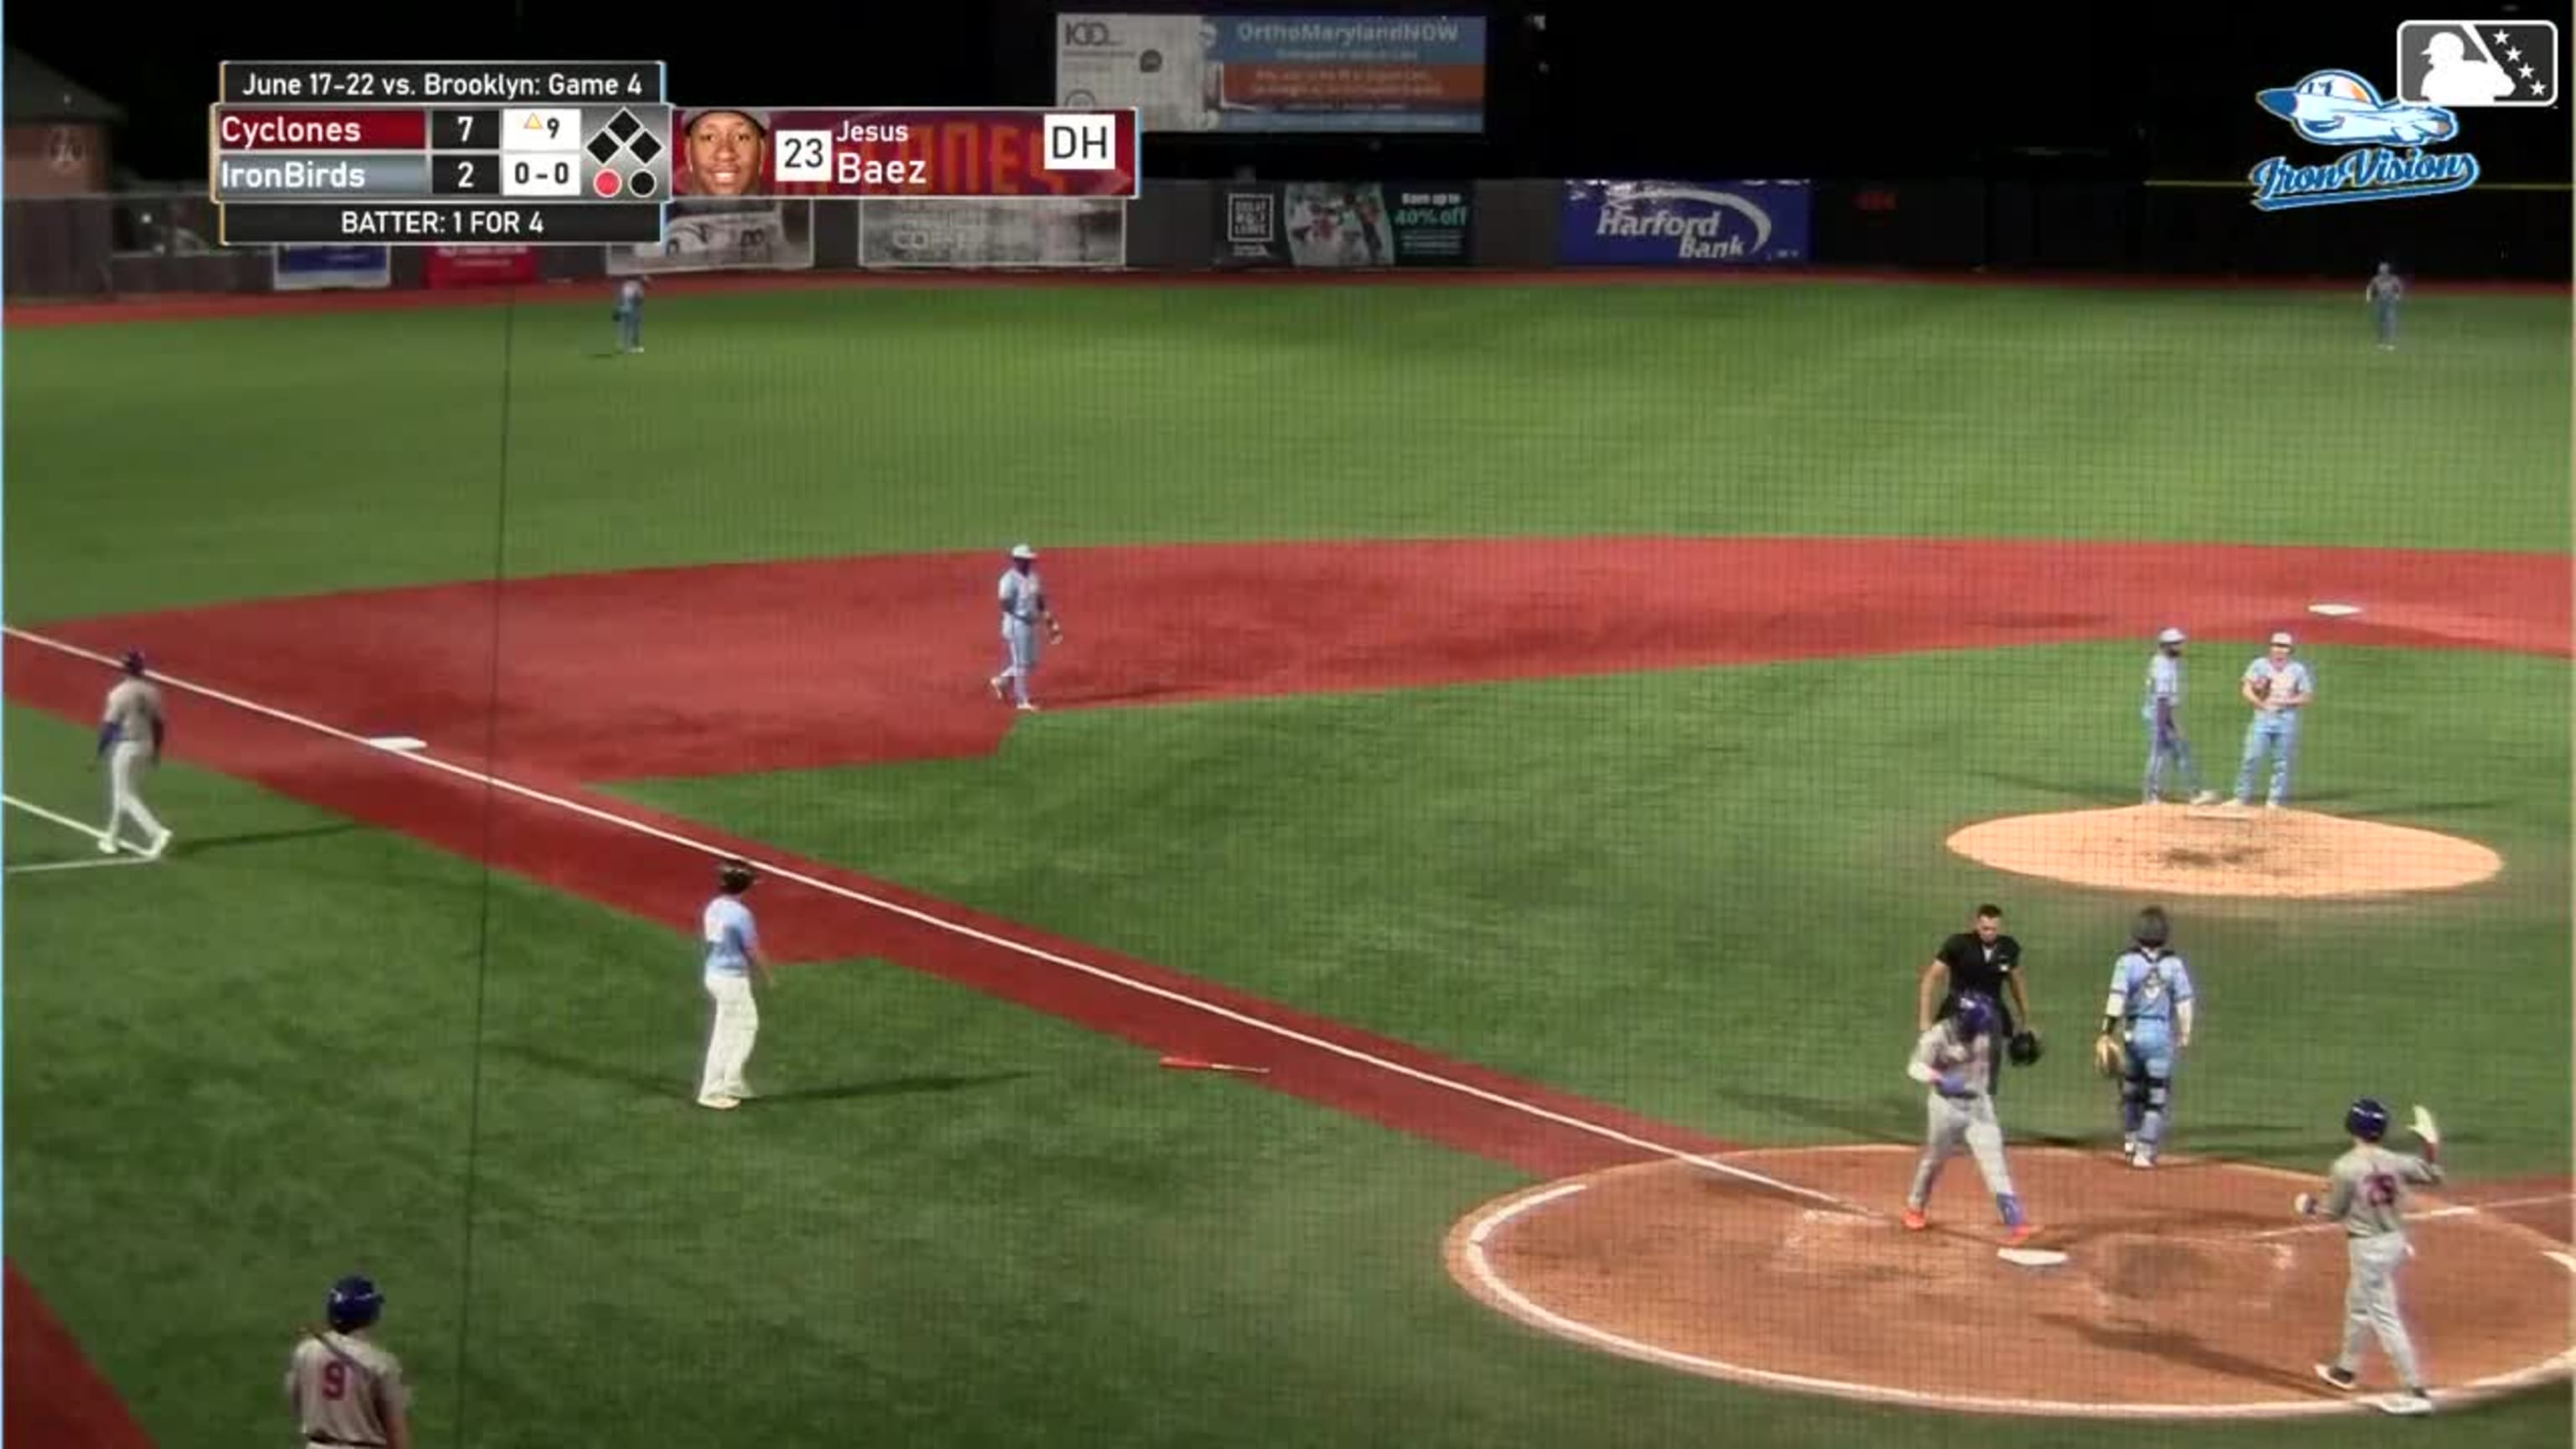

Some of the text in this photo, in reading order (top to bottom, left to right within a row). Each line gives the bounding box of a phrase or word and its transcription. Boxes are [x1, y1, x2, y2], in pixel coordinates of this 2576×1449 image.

[1237, 23, 1458, 45] OrthoMarylandNOW
[1394, 206, 1467, 226] 40% off
[1596, 209, 1721, 237] Harford
[1679, 234, 1745, 258] Bank
[322, 1359, 346, 1401] 9
